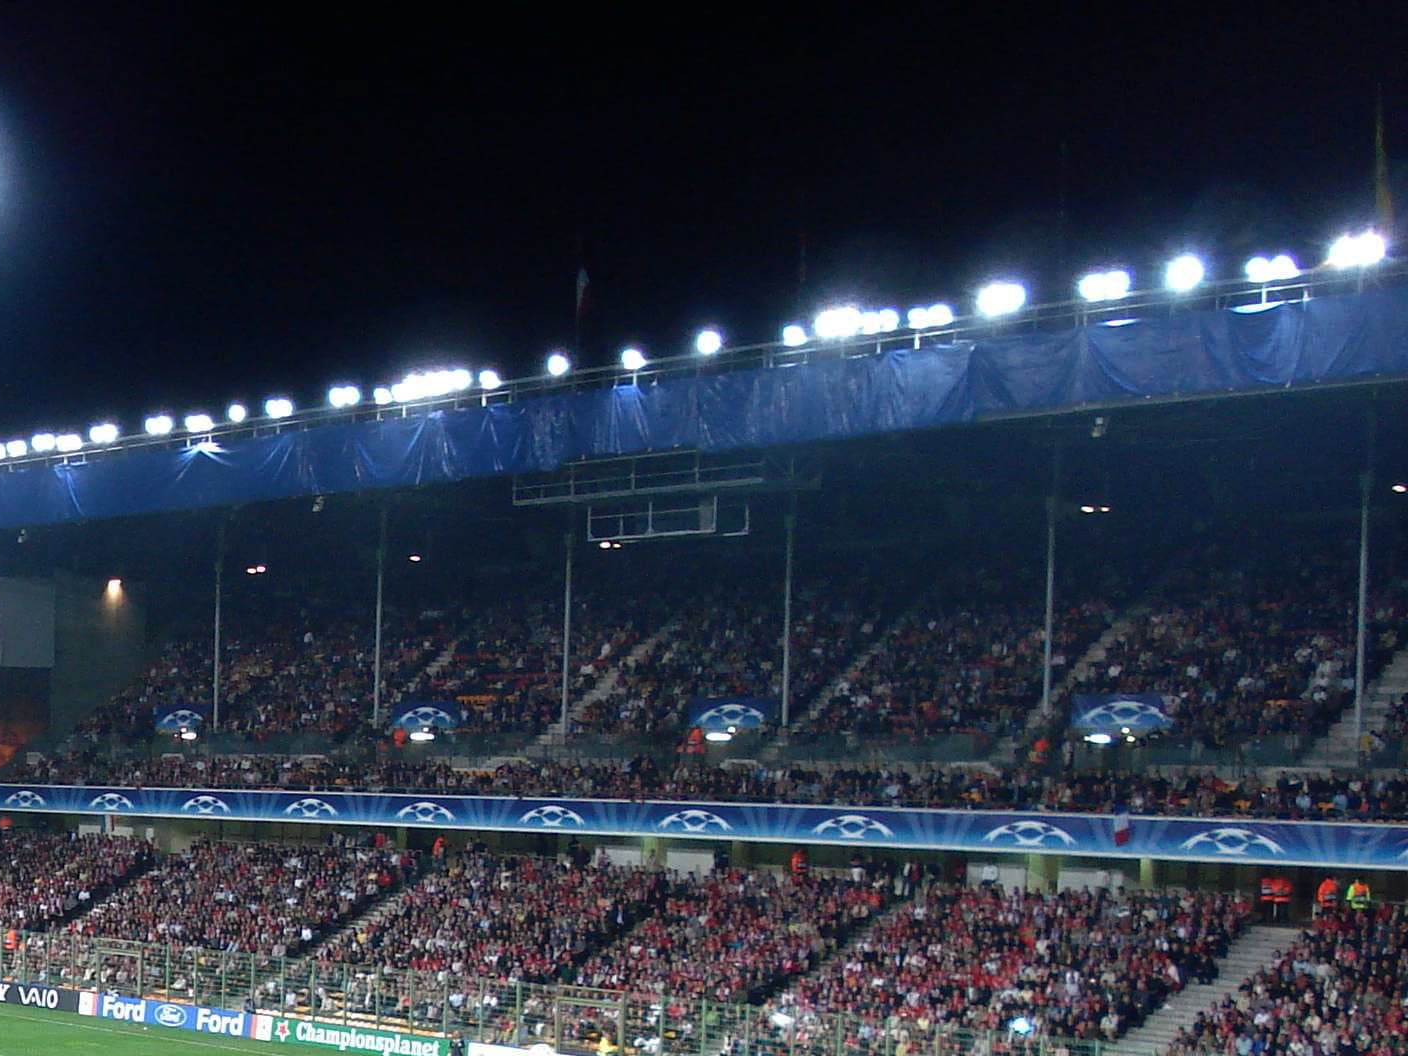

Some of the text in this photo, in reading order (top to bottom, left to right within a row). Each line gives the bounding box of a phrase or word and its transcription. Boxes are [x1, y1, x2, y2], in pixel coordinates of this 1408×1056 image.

[18, 986, 59, 1009] VAIO
[102, 995, 146, 1023] Ford
[195, 1008, 244, 1036] Ford
